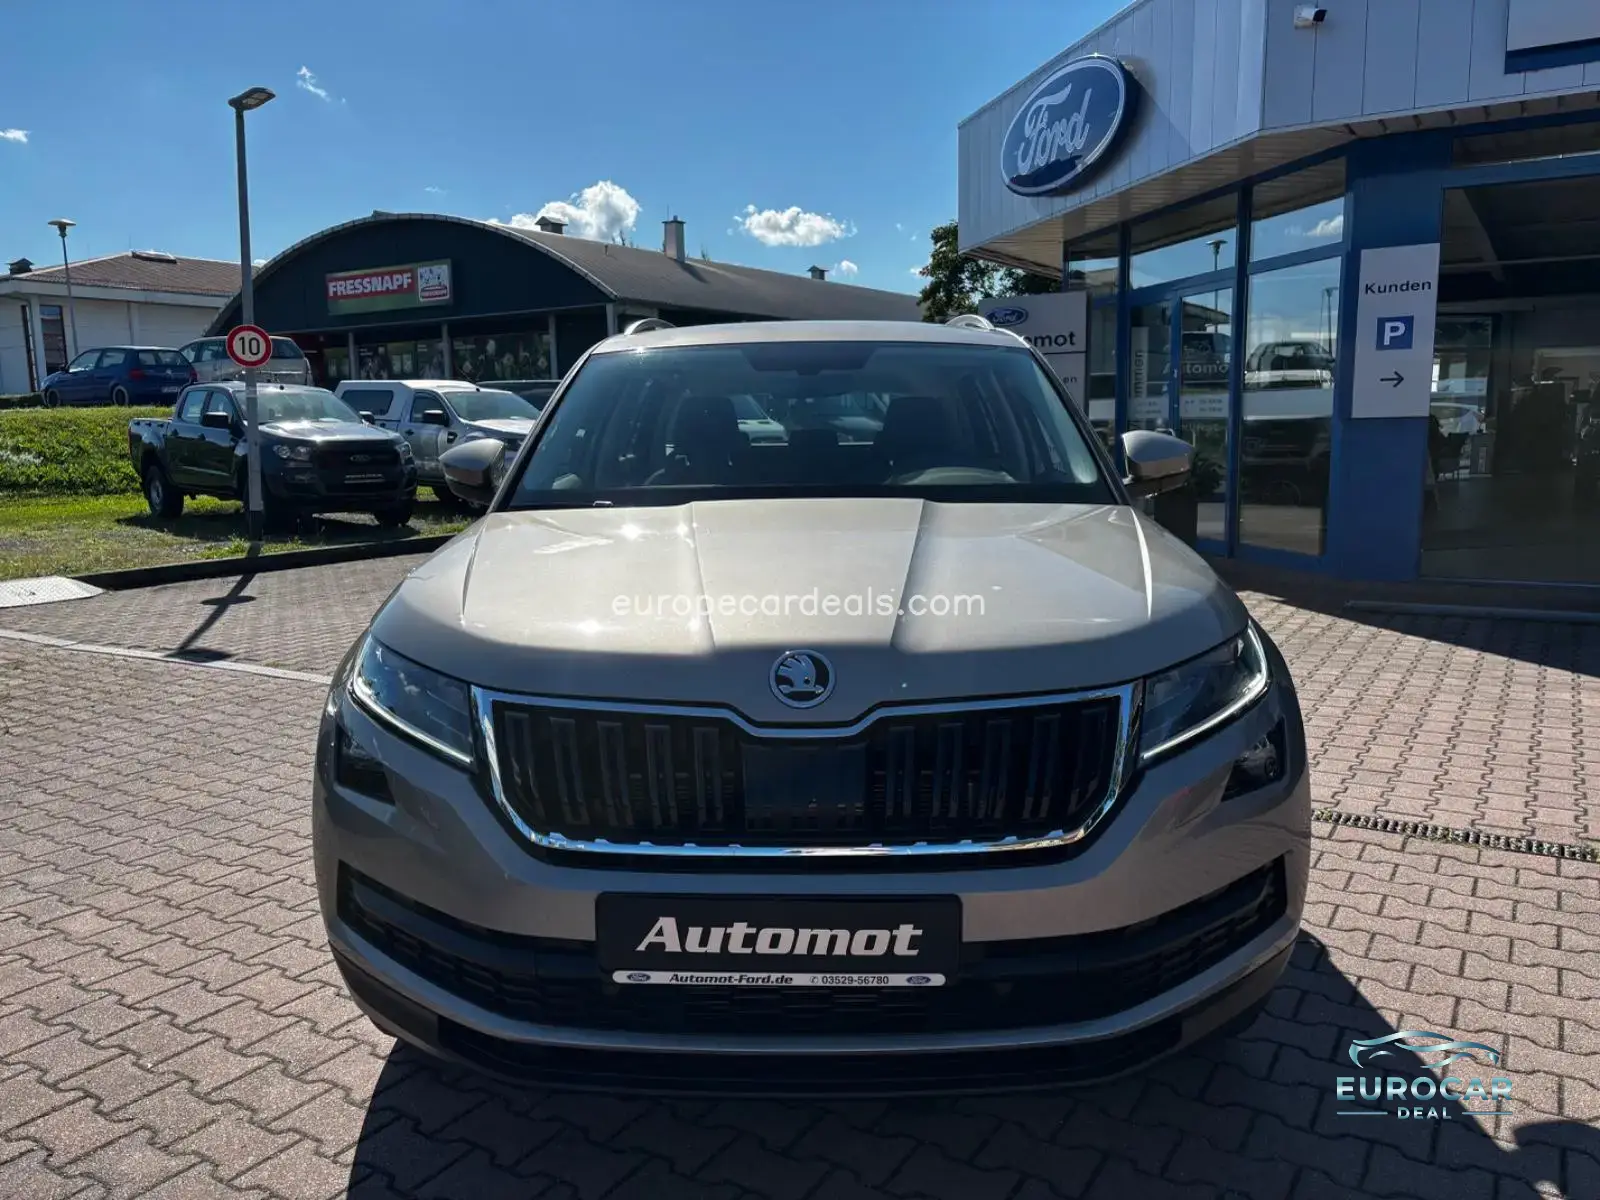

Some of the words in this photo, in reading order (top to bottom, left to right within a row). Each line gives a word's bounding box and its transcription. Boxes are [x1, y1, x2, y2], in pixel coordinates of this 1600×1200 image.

[1017, 82, 1091, 175] Ford
[328, 272, 412, 297] FRESSNAPF
[1364, 279, 1432, 295] Kunden
[1383, 320, 1406, 346] P
[238, 336, 261, 356] 10
[635, 916, 923, 956] Automot
[669, 973, 793, 985] Automot-Ford.de
[821, 975, 889, 985] 03529-56780
